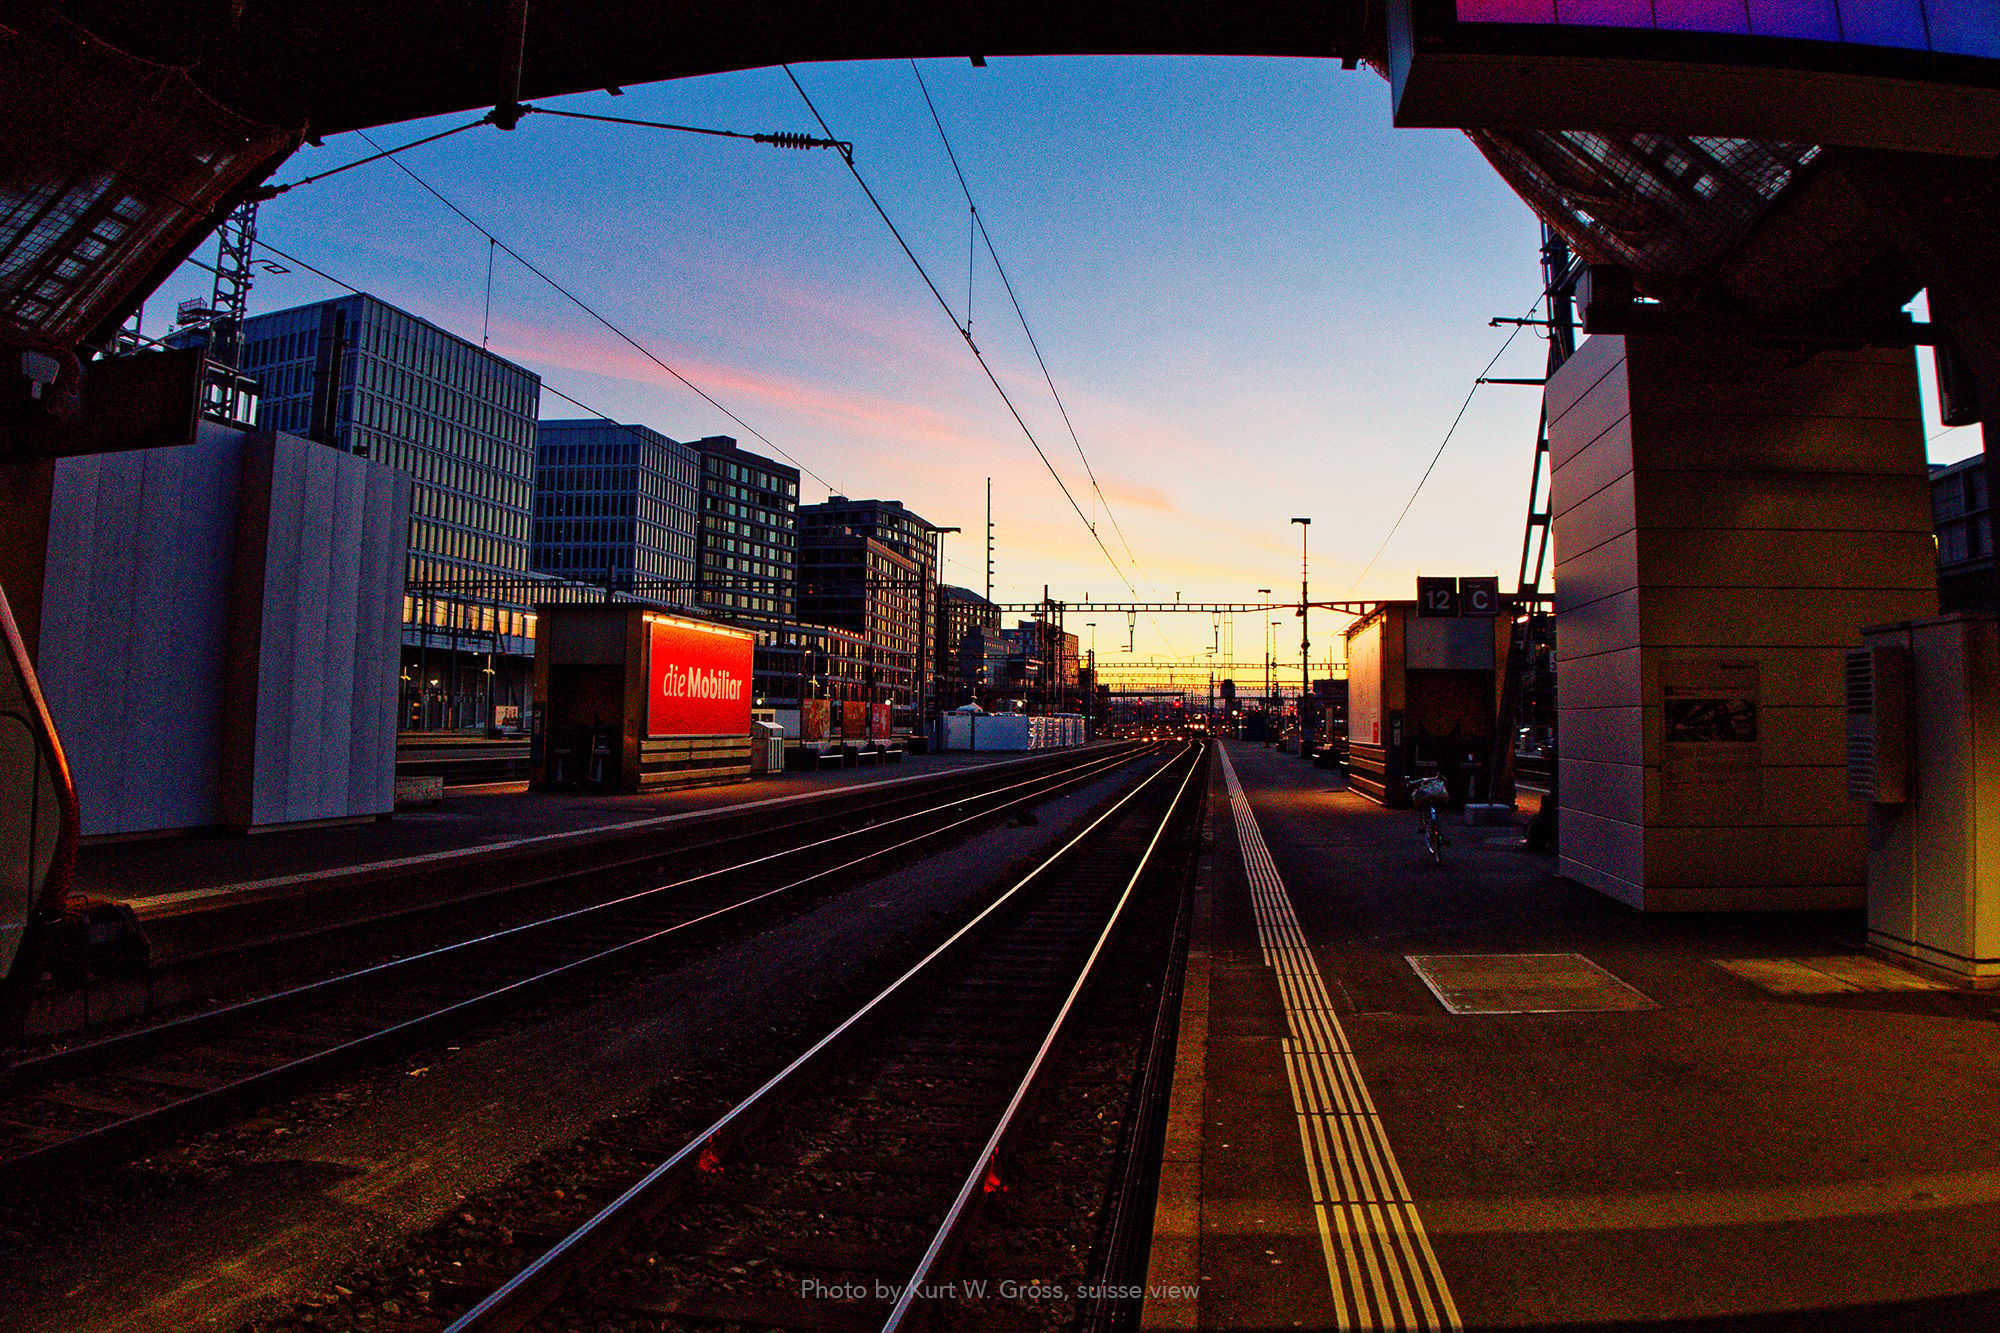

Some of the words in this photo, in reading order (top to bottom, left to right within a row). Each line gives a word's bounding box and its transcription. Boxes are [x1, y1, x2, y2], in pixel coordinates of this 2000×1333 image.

[1425, 590, 1451, 610] 12
[1472, 590, 1489, 610] C
[663, 663, 686, 697] die
[687, 666, 742, 700] Mobiliar
